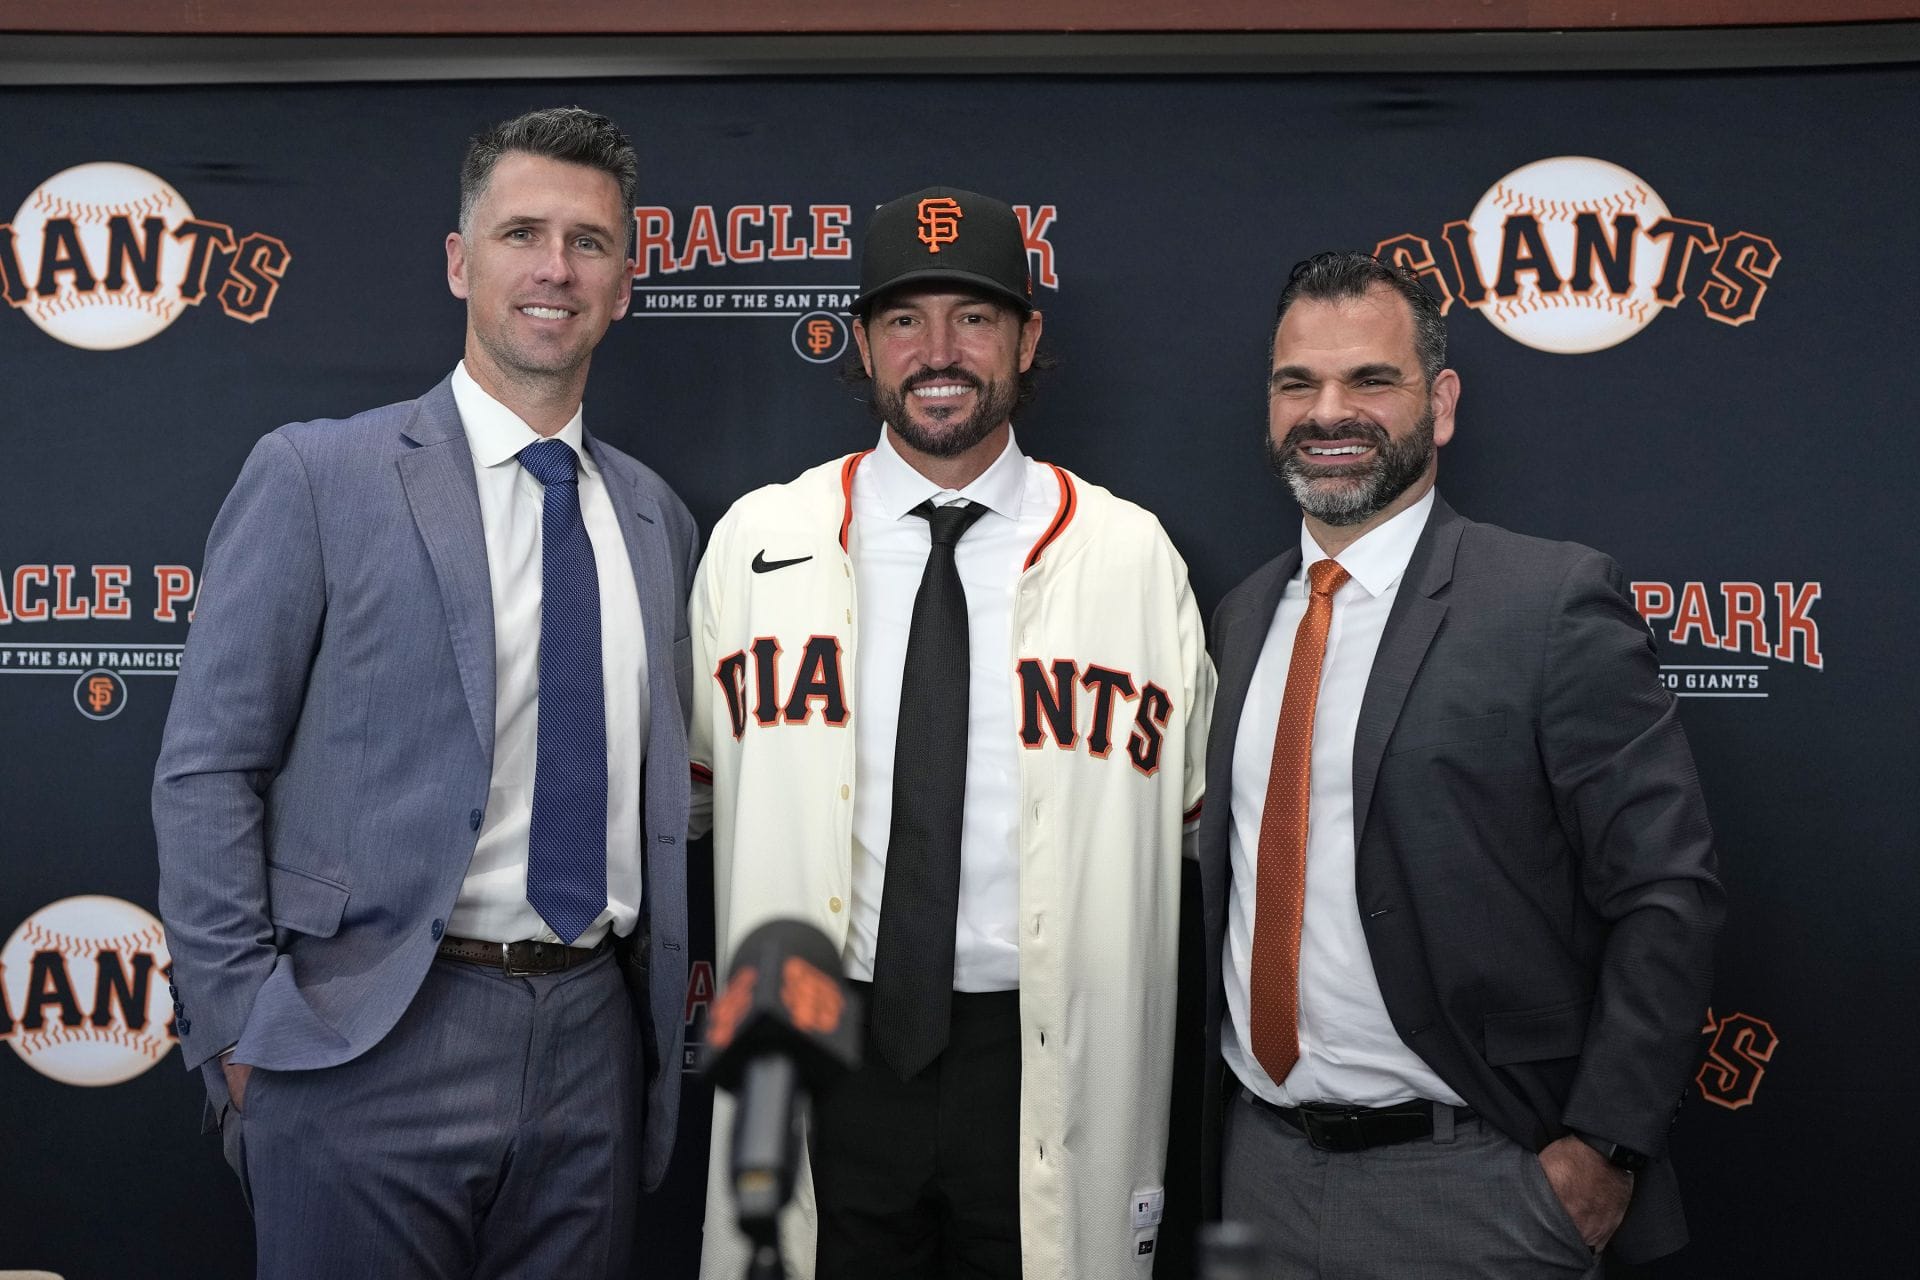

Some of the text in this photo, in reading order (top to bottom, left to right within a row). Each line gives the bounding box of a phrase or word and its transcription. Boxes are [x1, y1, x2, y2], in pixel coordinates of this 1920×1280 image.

[645, 294, 698, 309] HOME
[703, 294, 729, 309] OF
[732, 294, 767, 309] THE
[774, 294, 811, 308] SAN
[17, 651, 51, 666] THE
[57, 652, 92, 666] SAN
[1685, 673, 1760, 690] GIANTS
